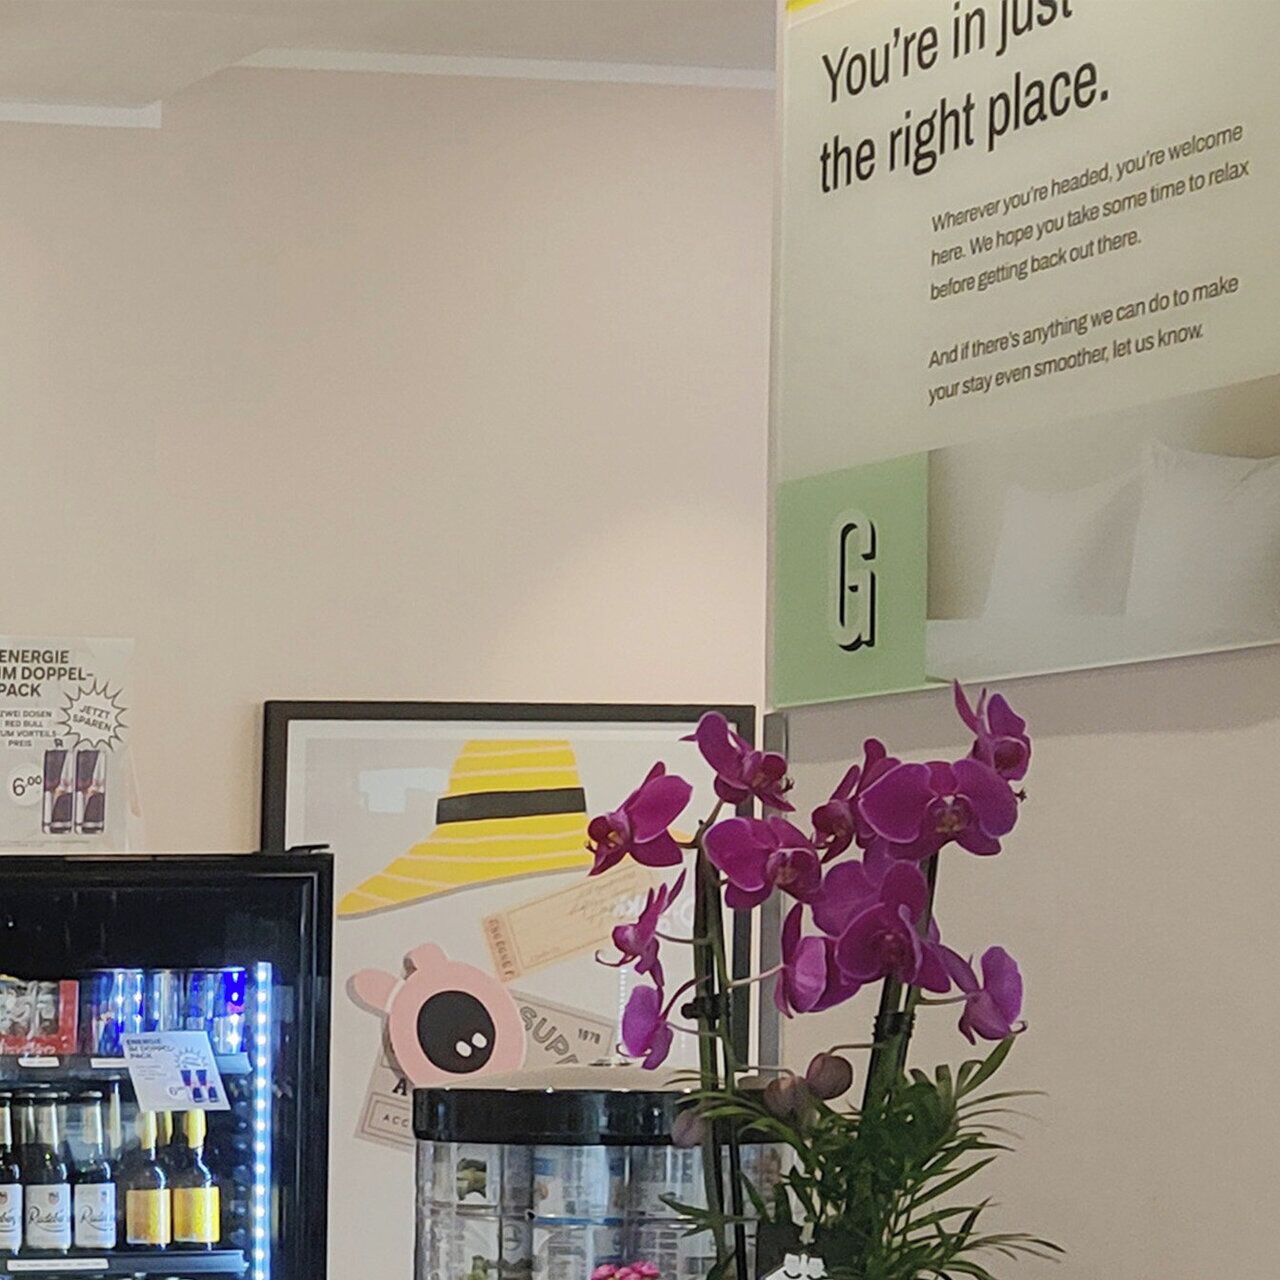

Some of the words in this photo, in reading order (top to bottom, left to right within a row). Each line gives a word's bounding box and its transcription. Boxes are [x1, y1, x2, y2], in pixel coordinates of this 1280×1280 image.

[822, 26, 938, 103] You're
[953, 1, 986, 59] in
[820, 135, 875, 193] the
[889, 93, 976, 176] right
[988, 62, 1108, 152] place.
[931, 200, 1001, 232] Wherever
[1002, 186, 1048, 216] you're
[1051, 162, 1113, 197] headed,
[1116, 149, 1165, 182] you're
[1168, 125, 1244, 160] welcome
[931, 245, 966, 266] here.
[970, 235, 993, 256] We
[996, 224, 1033, 248] hope
[1036, 215, 1064, 241] you
[1067, 204, 1100, 228] take
[1102, 191, 1147, 217] some
[1150, 179, 1186, 203] time
[1189, 173, 1205, 193] to
[1208, 160, 1249, 186] relax
[930, 275, 975, 301] before
[977, 257, 1029, 292] getting
[1031, 247, 1067, 274] back
[1069, 240, 1095, 262] out
[1097, 229, 1142, 256] there.
[928, 343, 958, 369] And
[960, 340, 970, 361] if
[971, 331, 1020, 358] there's
[1022, 313, 1088, 346] anything
[1090, 309, 1113, 328] we
[1116, 301, 1146, 321] can
[1149, 292, 1170, 313] do
[1173, 289, 1189, 307] to
[1192, 275, 1239, 302] make
[928, 381, 960, 406] your
[962, 373, 992, 394] stay
[995, 364, 1031, 387] even
[1034, 345, 1109, 378] smoother,
[1112, 338, 1131, 359] let
[1135, 335, 1154, 353] us
[1158, 323, 1204, 348] know.
[21, 666, 94, 681] DOPPEL-
[79, 705, 111, 720] JETZT
[4, 720, 22, 728] RED
